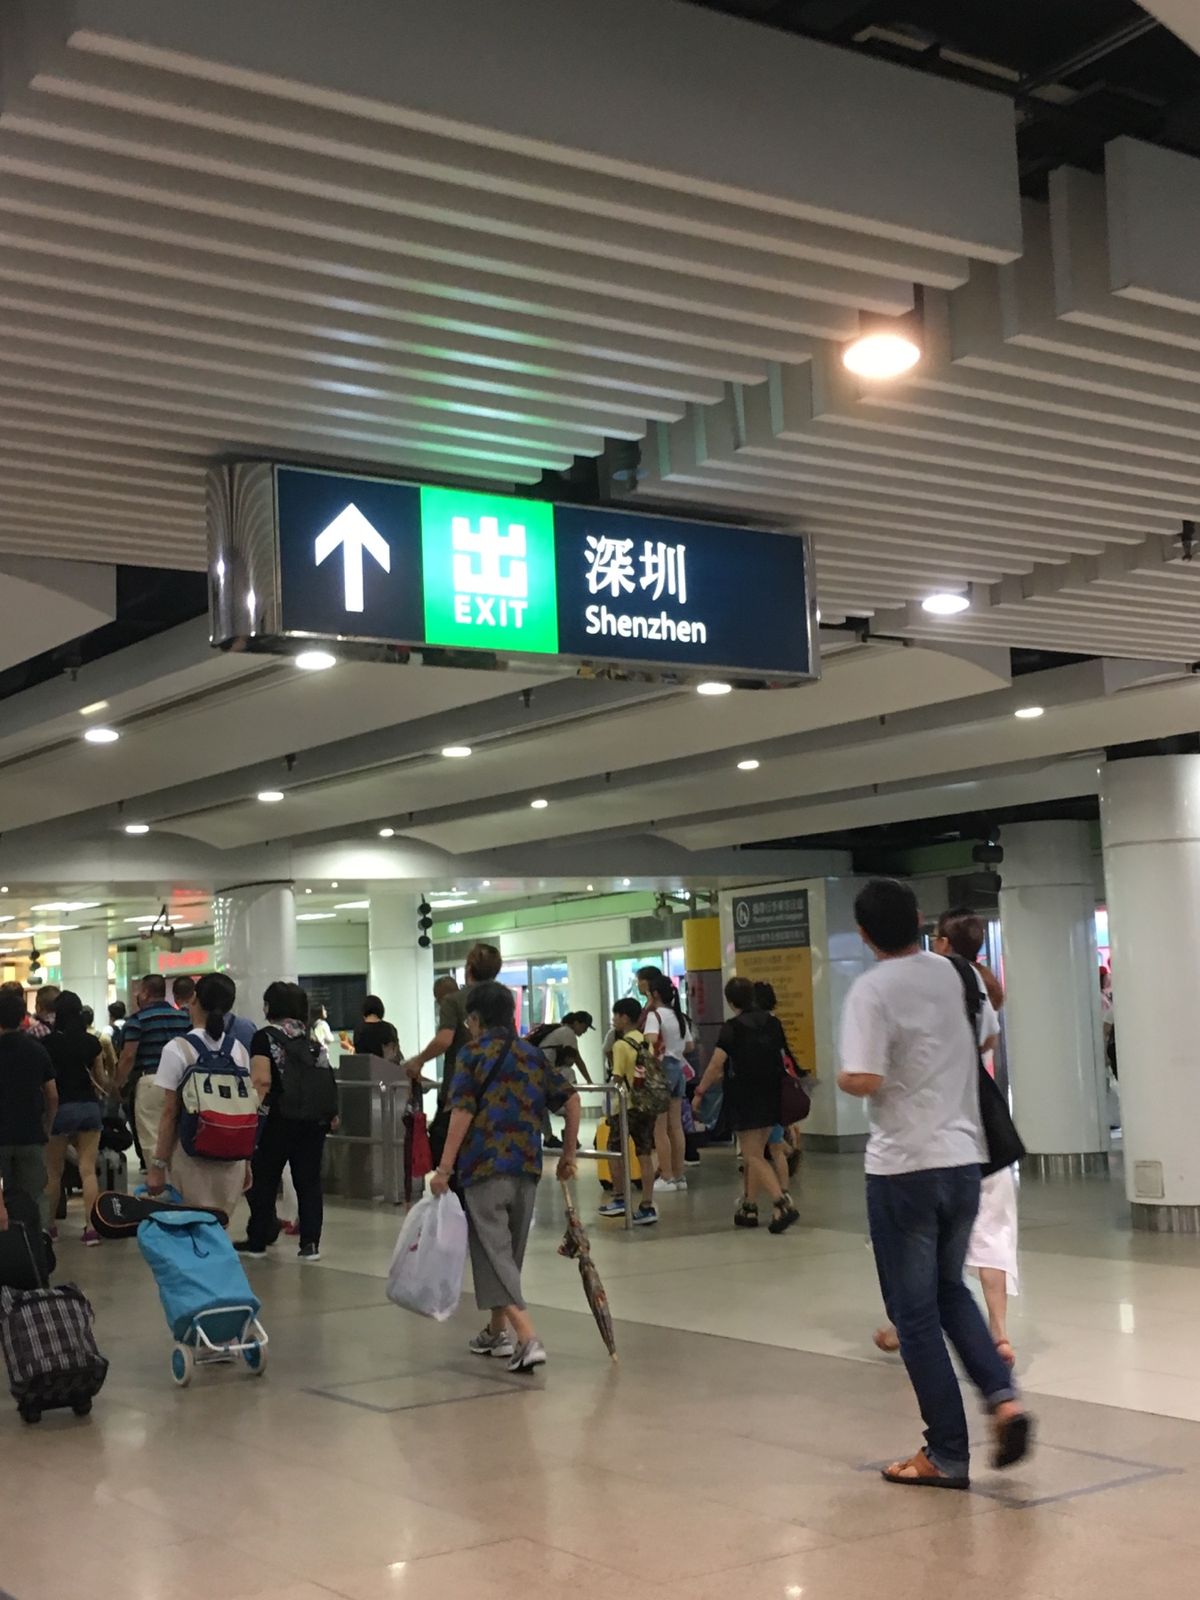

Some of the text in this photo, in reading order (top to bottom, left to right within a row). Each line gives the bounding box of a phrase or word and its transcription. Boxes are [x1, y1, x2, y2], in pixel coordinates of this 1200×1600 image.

[452, 516, 528, 596] 出
[584, 535, 687, 605] 深圳
[454, 596, 528, 628] EXIT
[585, 604, 707, 644] Shenzhen
